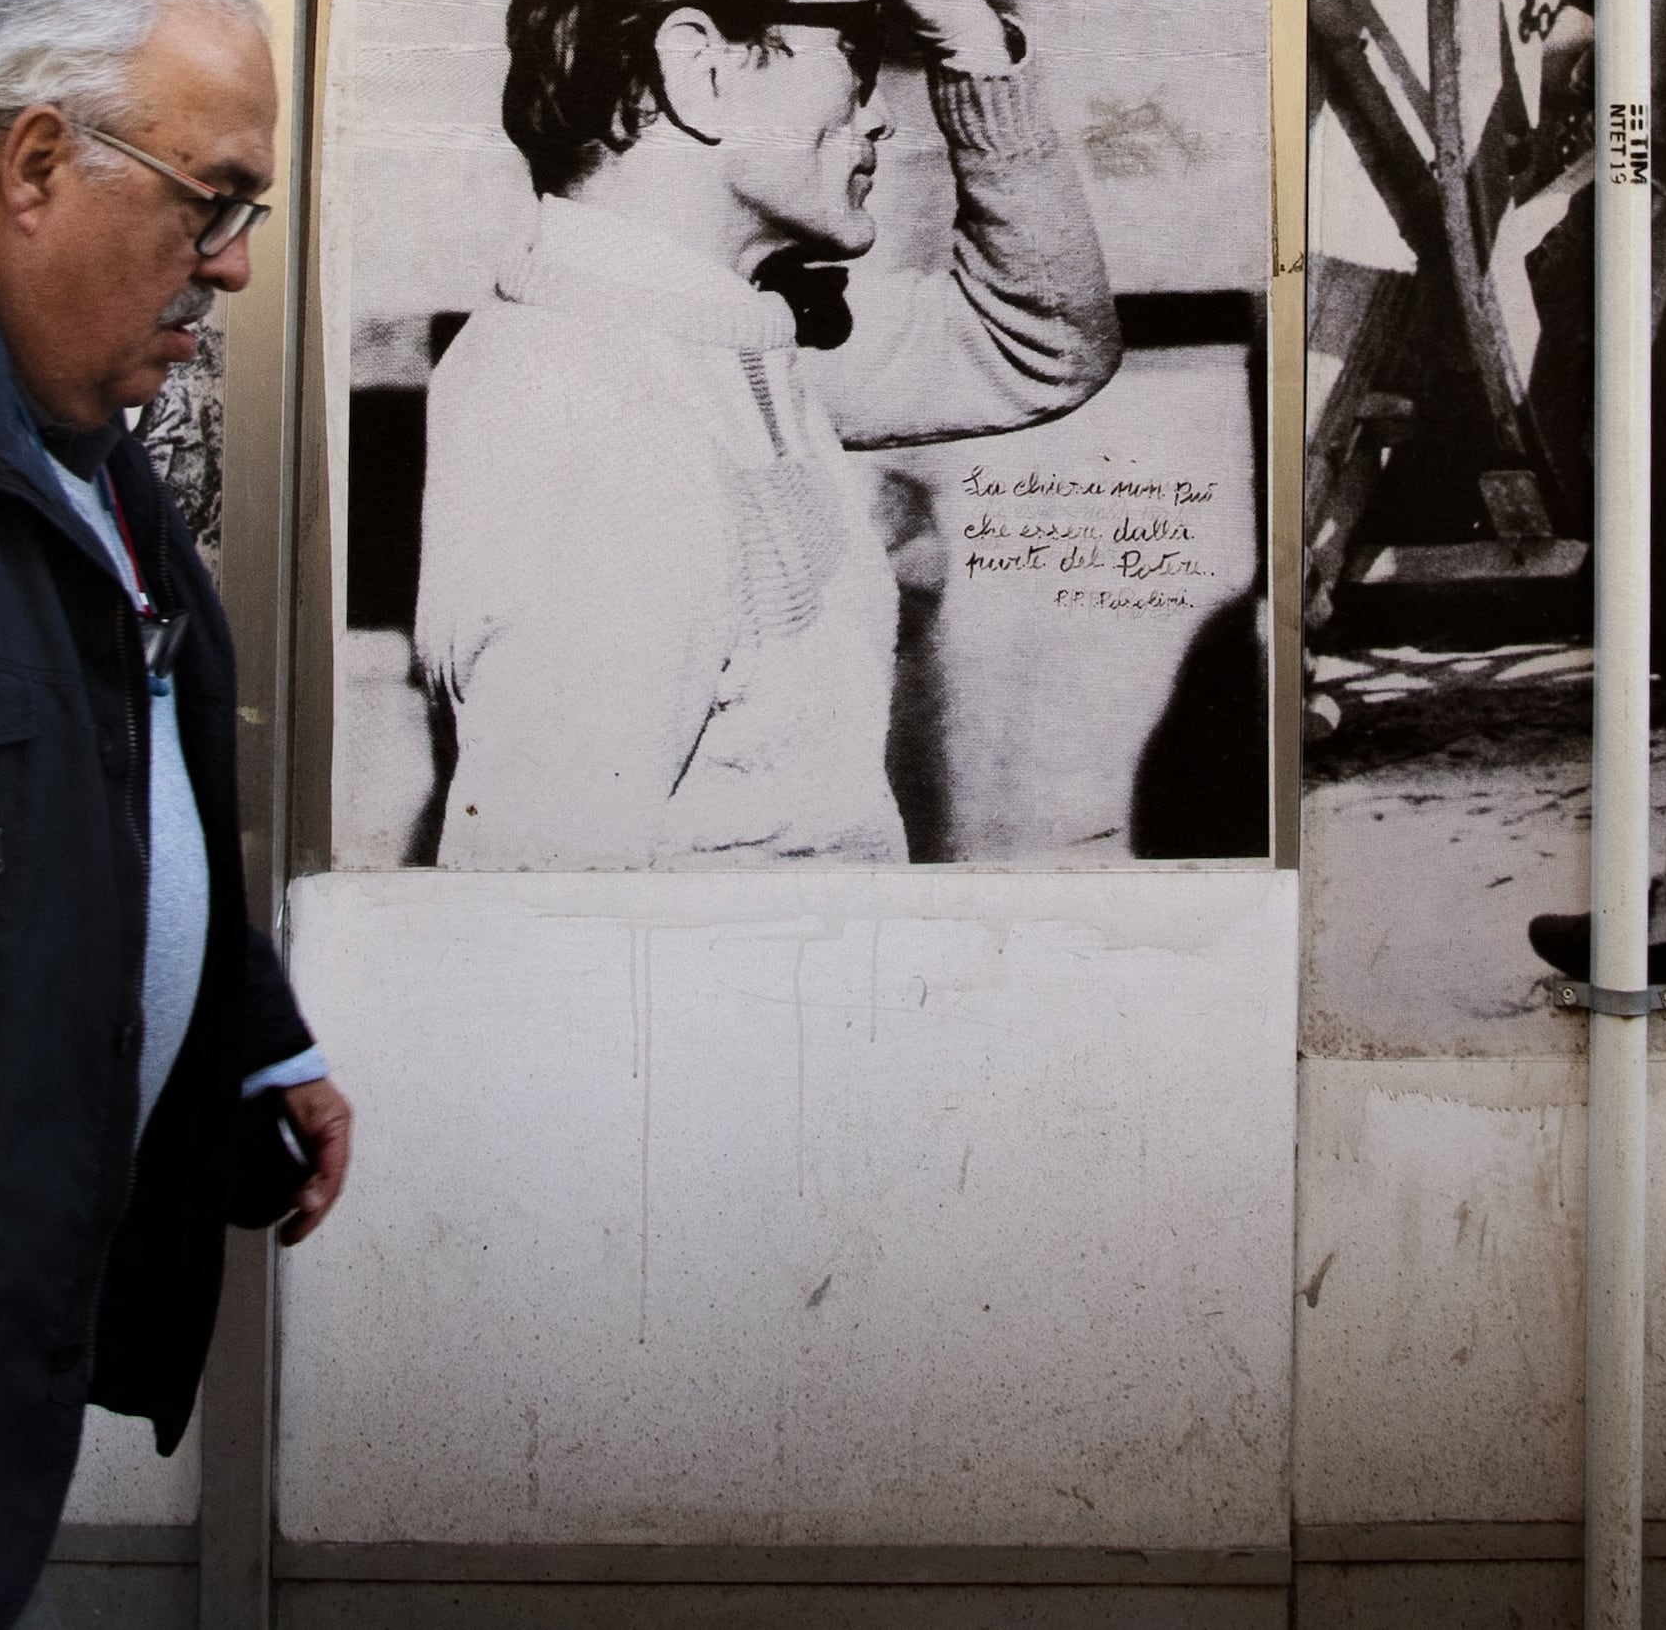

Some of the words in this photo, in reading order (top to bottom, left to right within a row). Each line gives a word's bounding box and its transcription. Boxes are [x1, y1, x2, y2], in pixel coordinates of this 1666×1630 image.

[1110, 480, 1165, 498] non
[964, 514, 1010, 540] che
[1113, 517, 1195, 543] dalla
[964, 545, 1051, 579] parte
[1059, 546, 1104, 573] del
